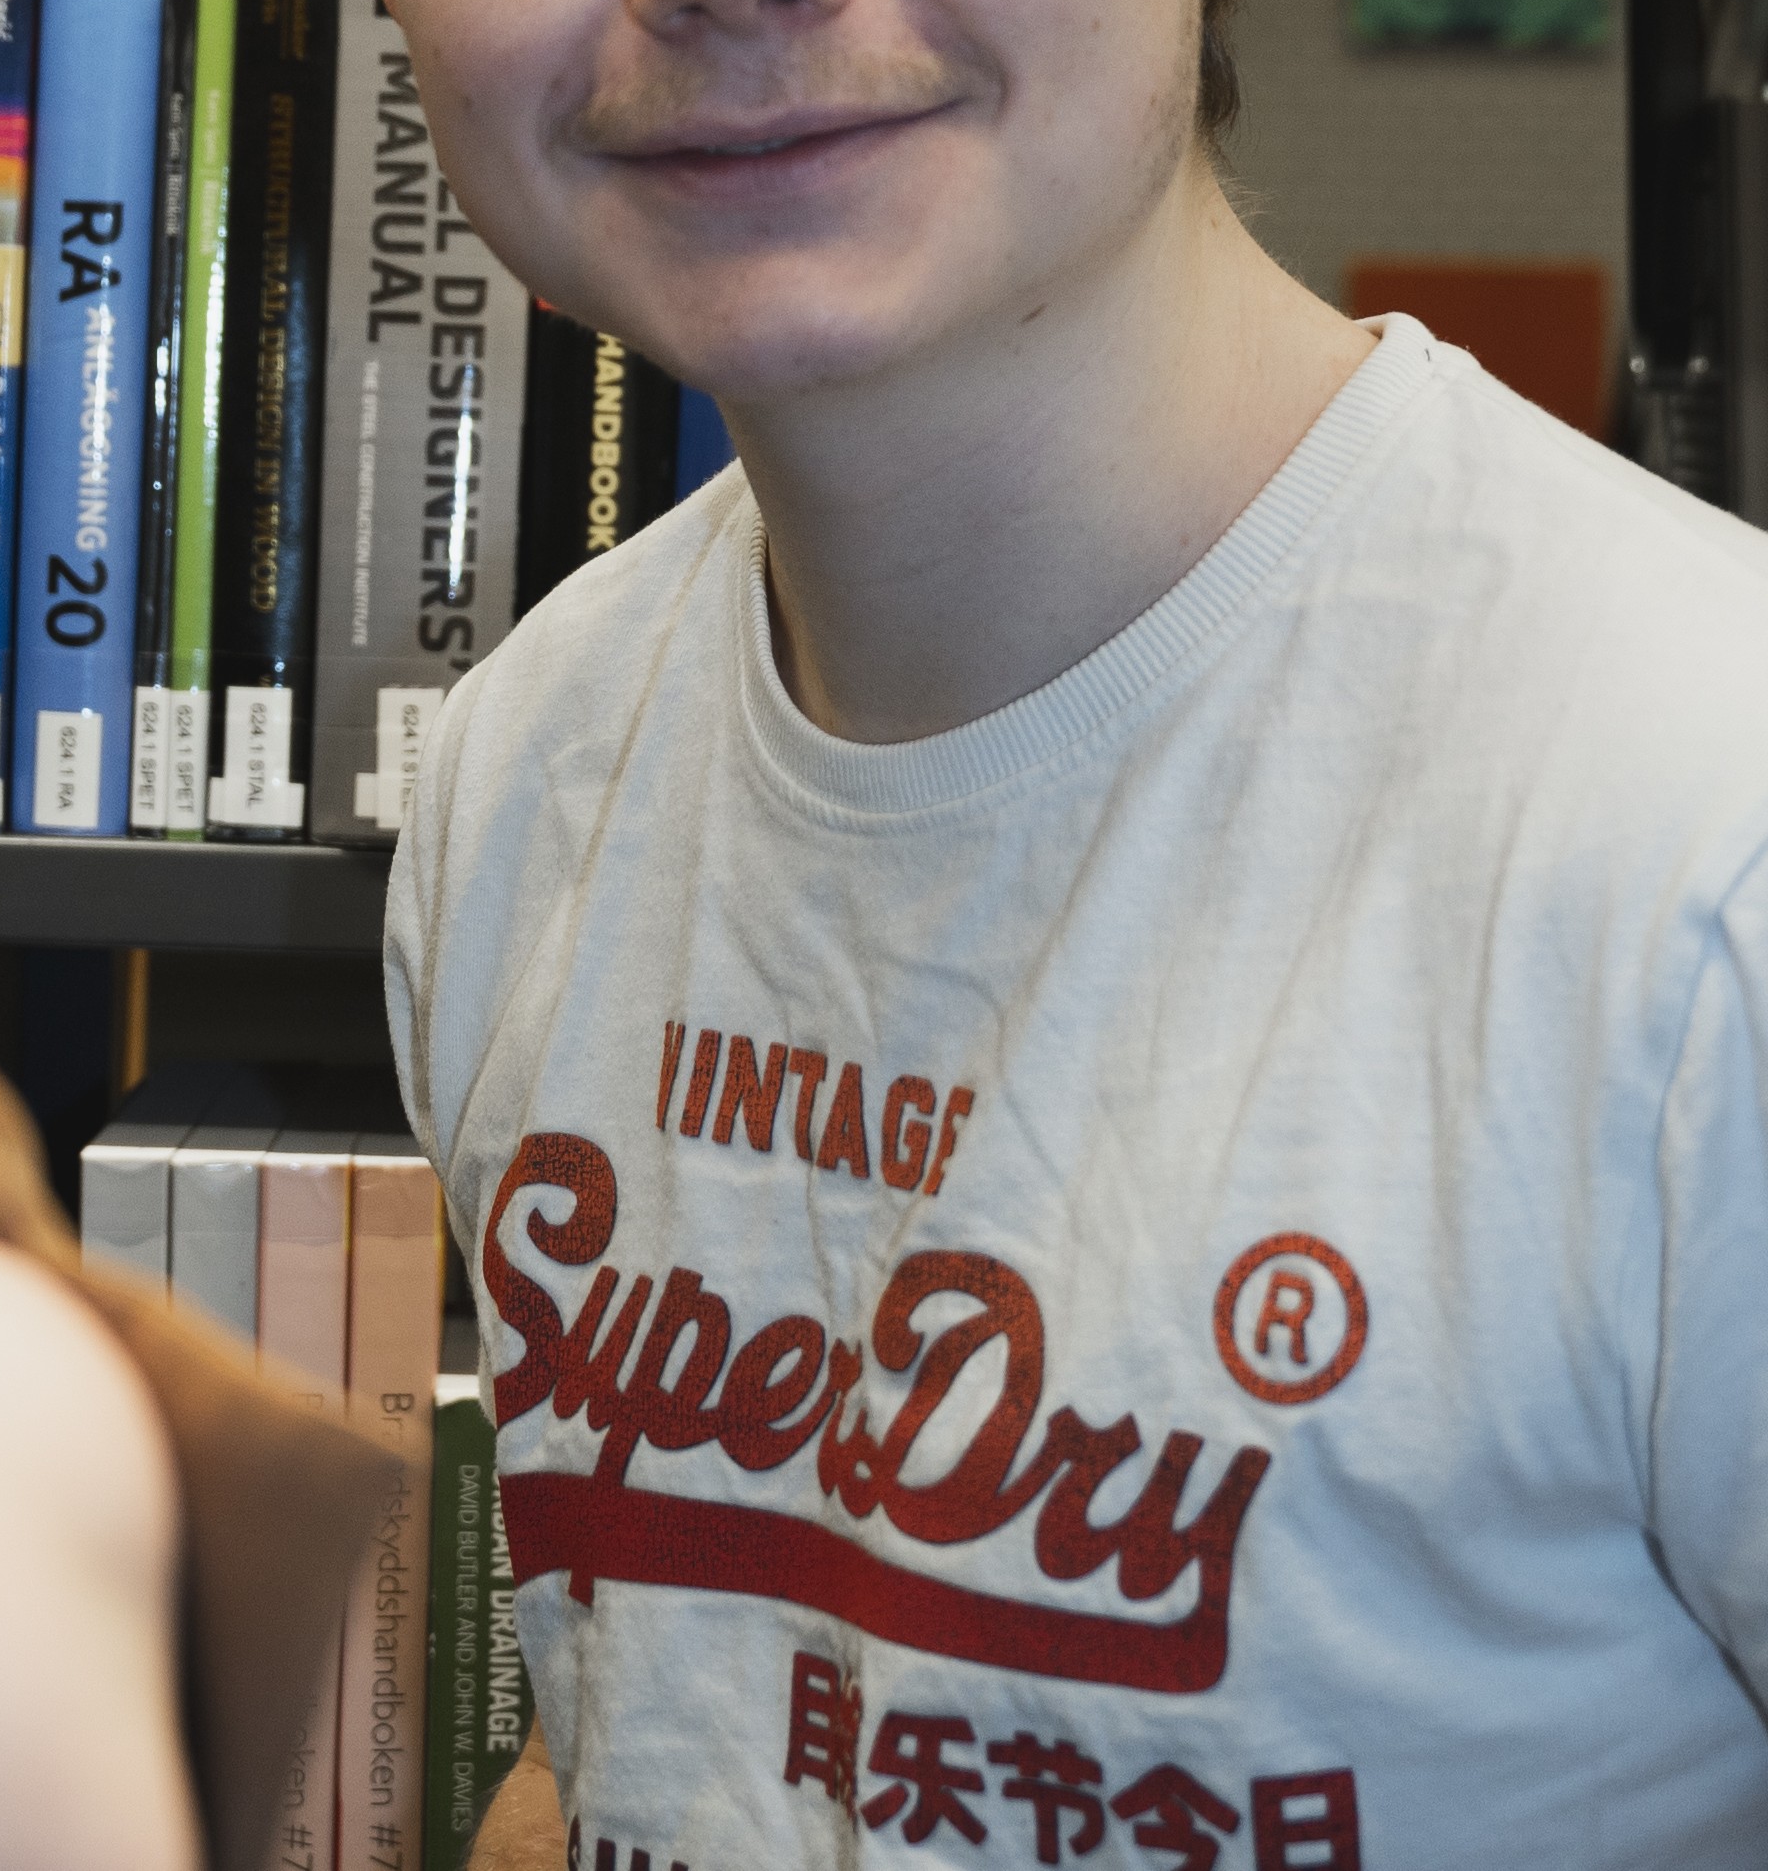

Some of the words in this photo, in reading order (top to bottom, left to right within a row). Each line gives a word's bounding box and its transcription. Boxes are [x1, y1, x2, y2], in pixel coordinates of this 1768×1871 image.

[259, 93, 295, 323] STRUCTURAL
[368, 50, 430, 343] MANUAL
[58, 199, 125, 305] RÅ
[255, 326, 288, 451] DESIGN
[359, 393, 379, 441] STEEL
[362, 361, 380, 392] THE
[75, 305, 121, 553] ANLÄGGNING
[587, 331, 627, 551] HANDBOOK
[254, 456, 282, 495] IN
[355, 443, 376, 564] CONSTRUCTION
[250, 501, 280, 614] WOOD
[44, 553, 109, 649] 20
[352, 566, 372, 647] INSTITUTE
[139, 758, 158, 811] SPET
[175, 761, 195, 813] SPET
[246, 759, 267, 811] STAL
[457, 1463, 481, 1525] DAVID
[455, 1530, 480, 1612] BUTLER
[454, 1616, 477, 1663] AND
[486, 1588, 522, 1753] DRAINAGE
[453, 1670, 477, 1725] JOHN
[452, 1730, 475, 1755] W.
[450, 1760, 475, 1832] DAVIES
